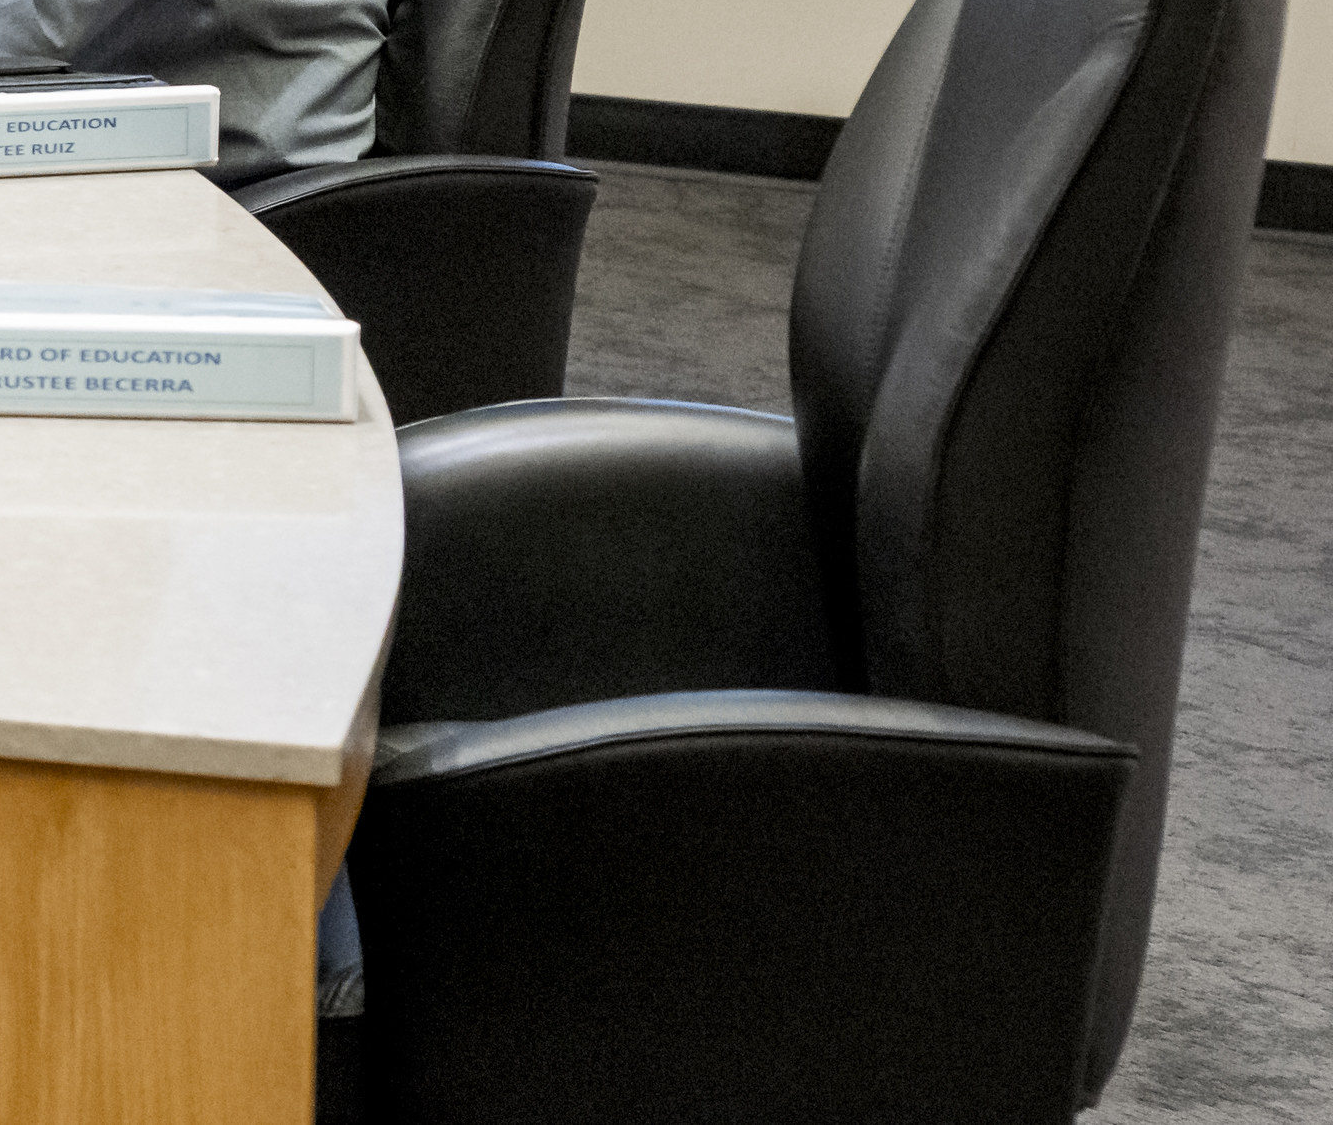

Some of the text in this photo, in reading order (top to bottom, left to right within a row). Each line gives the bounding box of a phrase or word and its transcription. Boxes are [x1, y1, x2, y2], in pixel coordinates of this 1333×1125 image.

[7, 117, 118, 133] EDUCATION
[32, 142, 76, 155] RUIZ
[40, 348, 72, 362] OF
[80, 349, 222, 365] EDUCATION
[85, 377, 194, 393] BECERRA
